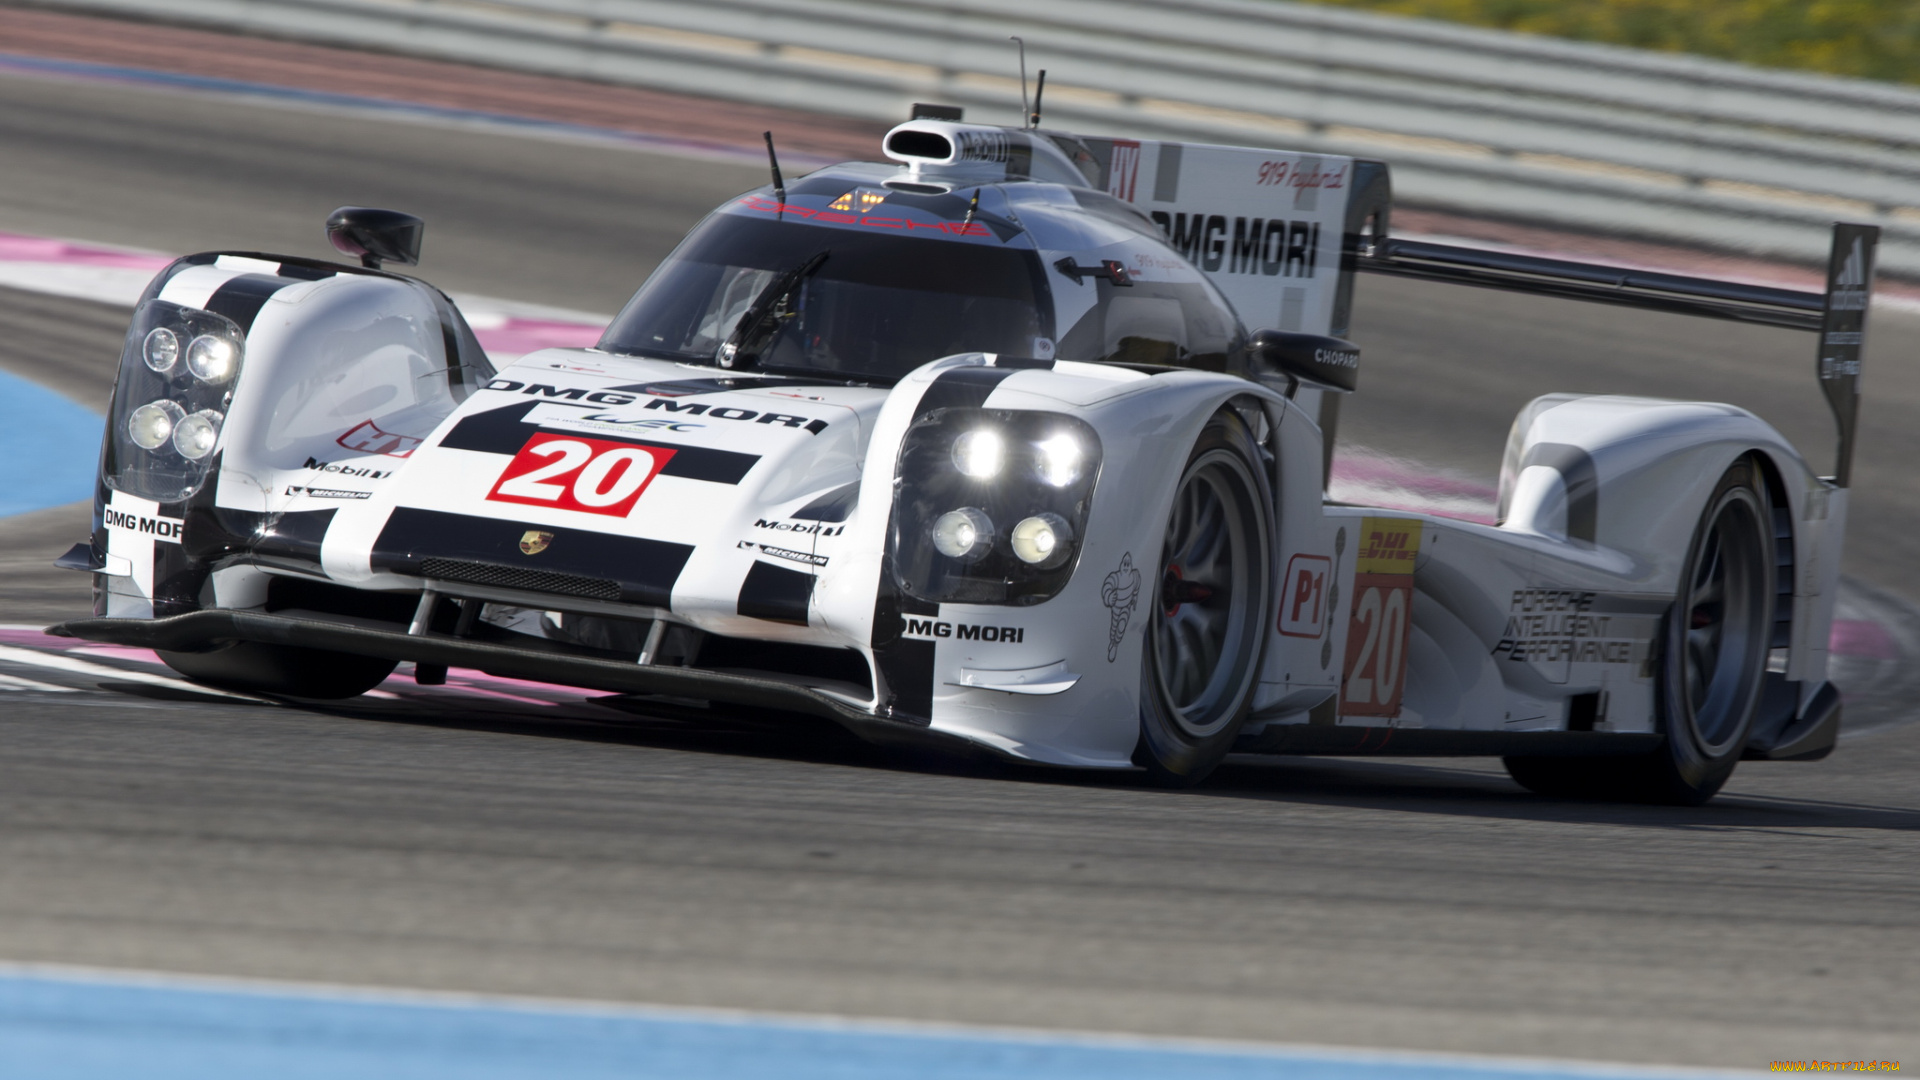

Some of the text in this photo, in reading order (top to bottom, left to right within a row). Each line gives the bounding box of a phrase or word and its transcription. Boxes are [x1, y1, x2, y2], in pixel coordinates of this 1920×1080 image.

[1257, 161, 1288, 186] 919
[738, 195, 992, 236] PORSCHE
[1230, 217, 1321, 278] MORI
[485, 379, 829, 436] DMG MORI
[303, 456, 370, 477] Mobil
[497, 440, 655, 508] 20
[311, 489, 371, 499] MICHELIN
[105, 509, 136, 530] DMG
[754, 518, 822, 534] Mobil
[763, 546, 827, 565] MICHELIN
[1367, 531, 1410, 559] DHL
[1291, 569, 1324, 624] P1
[1511, 590, 1595, 612] PORSCHE
[901, 618, 1024, 643] MG MORI
[1503, 614, 1611, 637] INTELLIGENT
[1346, 586, 1406, 705] 20
[1490, 639, 1630, 662] PERFORMANCE
